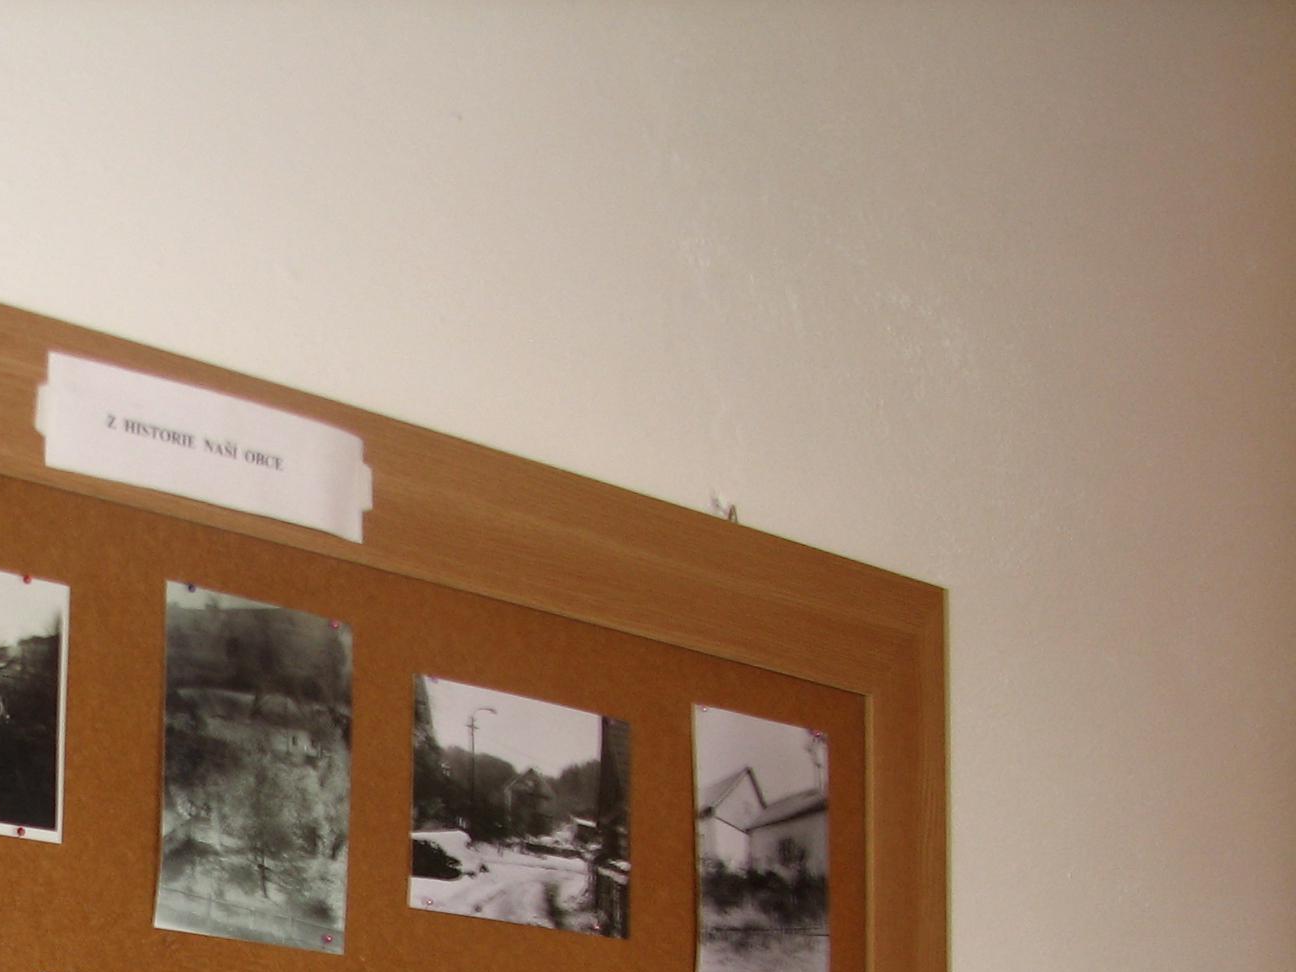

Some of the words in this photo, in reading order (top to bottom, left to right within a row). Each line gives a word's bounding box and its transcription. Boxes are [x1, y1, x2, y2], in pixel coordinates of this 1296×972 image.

[106, 413, 117, 430] Z
[124, 418, 195, 448] HISTORIE
[244, 449, 285, 471] OBCE
